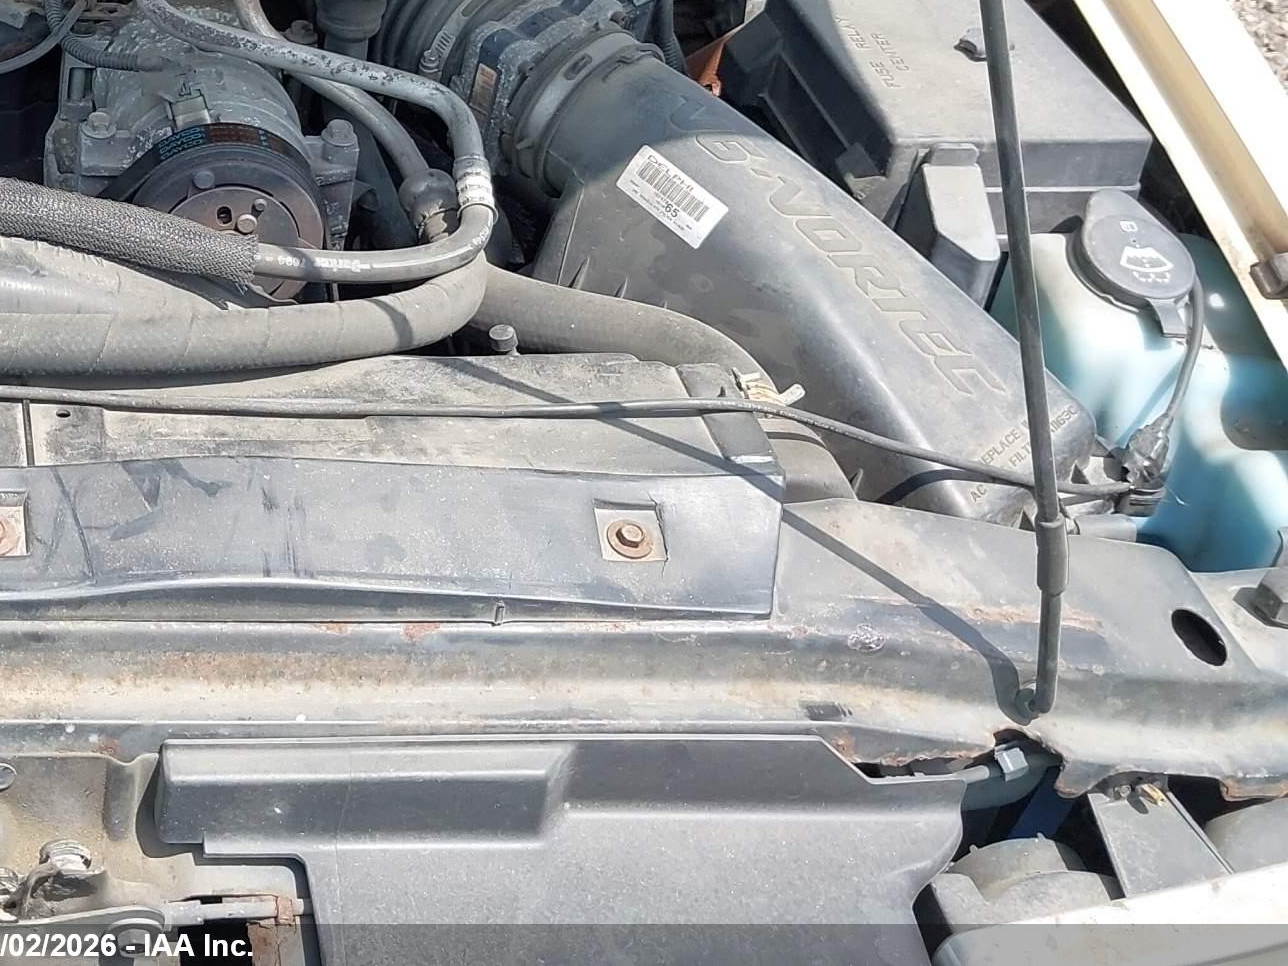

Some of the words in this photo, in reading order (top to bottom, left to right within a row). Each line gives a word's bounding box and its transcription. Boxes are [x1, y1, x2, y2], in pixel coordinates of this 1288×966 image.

[839, 16, 873, 52] RELAY
[872, 31, 910, 73] CENTER
[869, 59, 899, 89] FUSE
[158, 127, 201, 148] DAYCO
[160, 133, 202, 154] DAYCO
[161, 139, 203, 160] DAYCO
[647, 154, 694, 191] DELPHI
[665, 203, 680, 218] 65
[970, 484, 987, 502] AC
[1009, 441, 1031, 467] FILT
